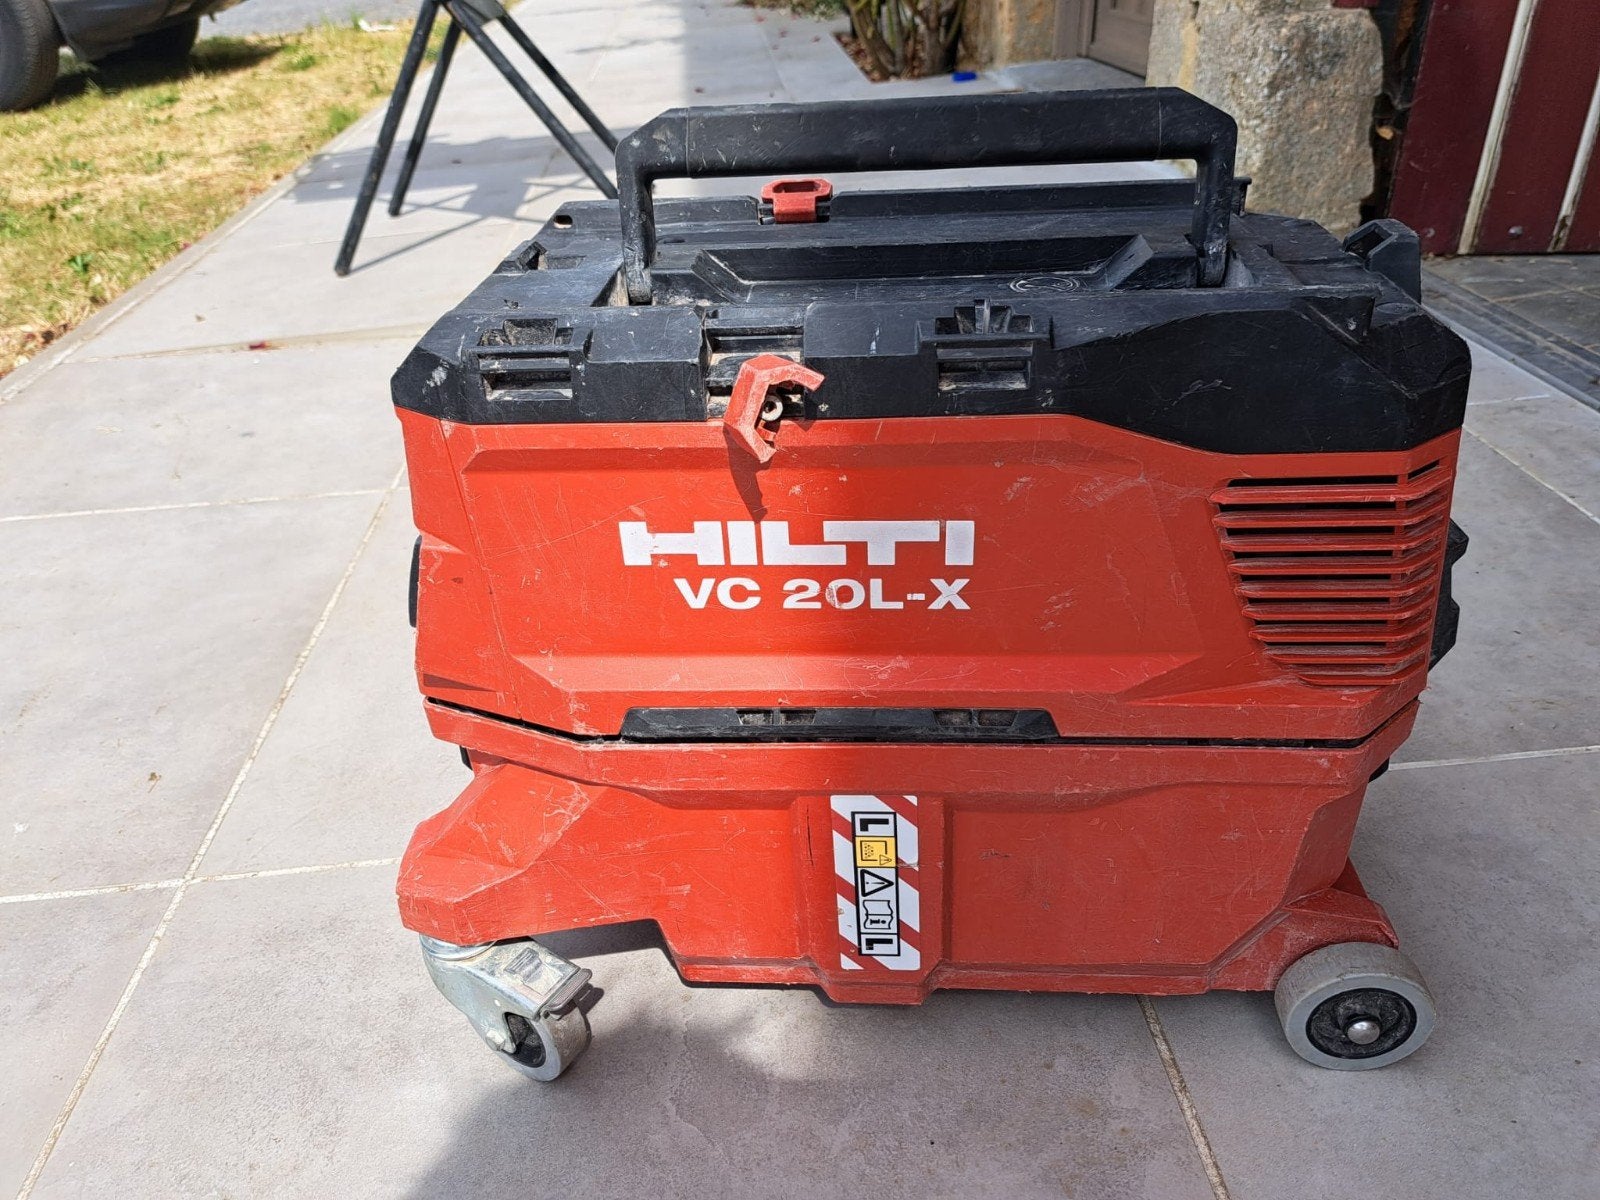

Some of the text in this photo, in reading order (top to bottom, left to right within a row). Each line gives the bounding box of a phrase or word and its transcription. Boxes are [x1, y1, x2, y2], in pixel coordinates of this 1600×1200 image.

[618, 520, 975, 566] HILTI
[673, 577, 971, 610] VC 20L-X
